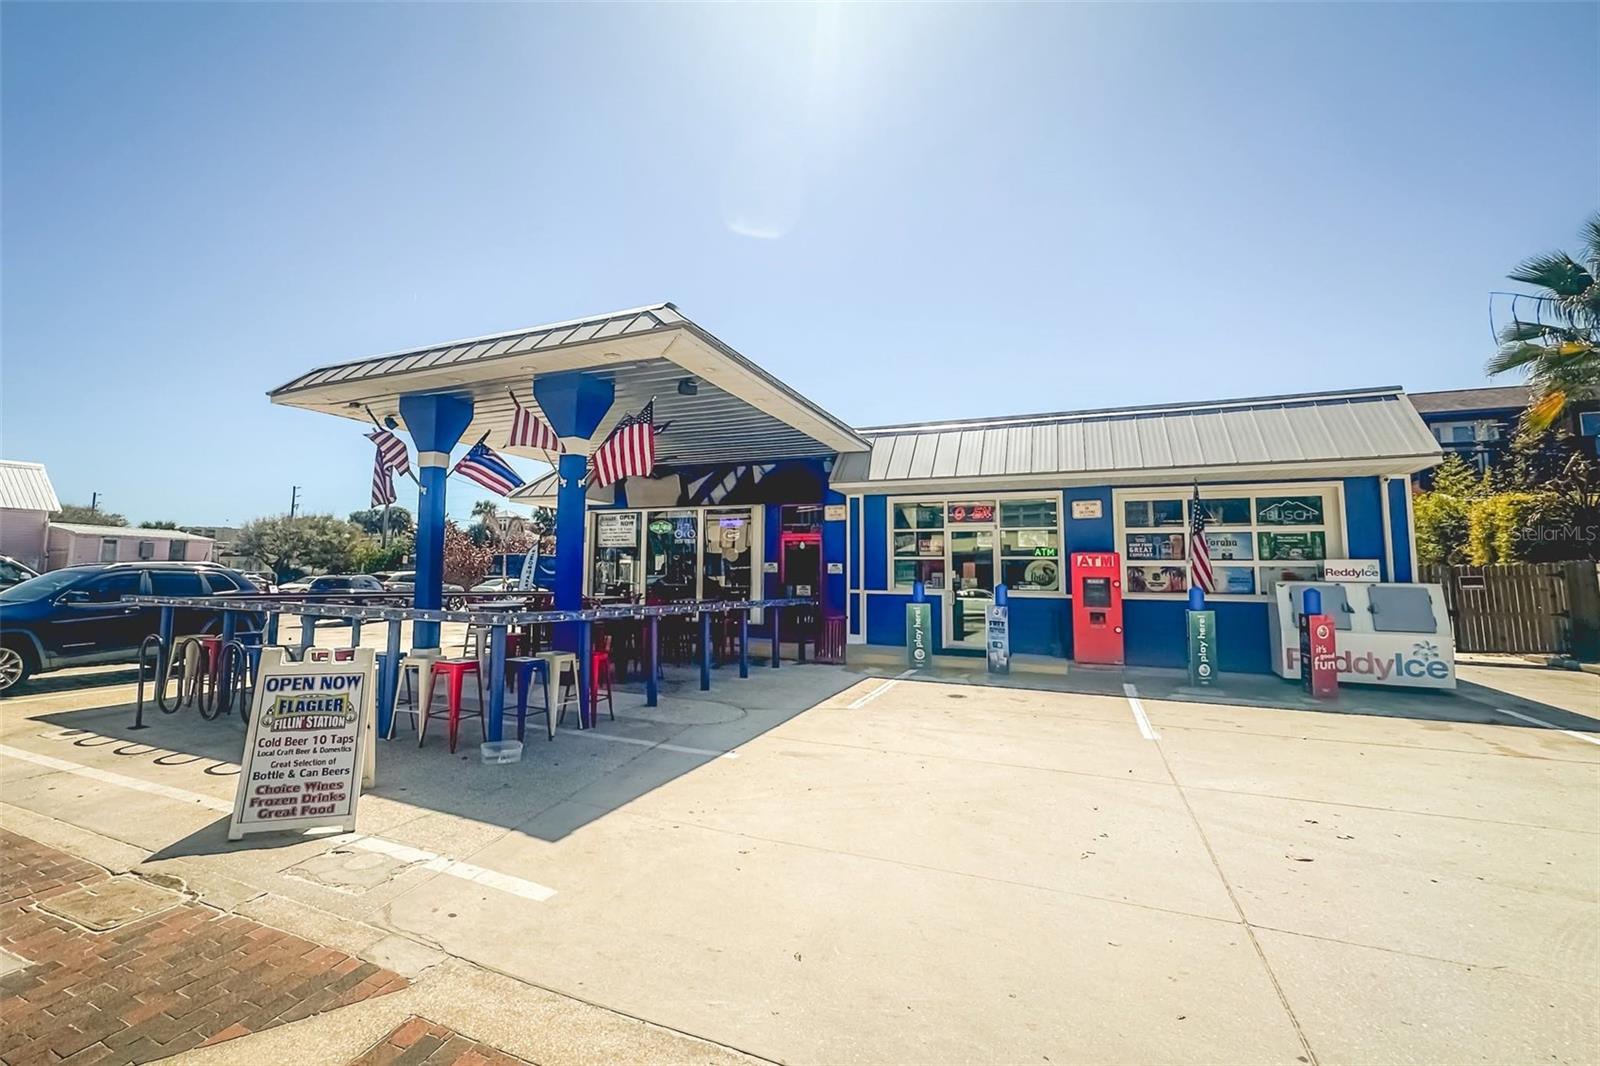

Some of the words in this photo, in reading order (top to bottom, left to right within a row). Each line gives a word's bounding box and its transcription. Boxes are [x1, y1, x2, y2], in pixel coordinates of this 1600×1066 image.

[1266, 510, 1313, 520] BUSCH
[1034, 548, 1055, 556] ATM
[1077, 555, 1114, 567] ATM
[913, 628, 924, 648] play
[1197, 640, 1209, 663] play
[1315, 644, 1327, 654] it's
[1314, 656, 1336, 670] fun
[266, 677, 315, 692] OPEN
[320, 675, 362, 690] NOW
[278, 698, 344, 714] FLAGLER
[306, 715, 345, 729] STATION
[258, 737, 281, 748] Cold
[284, 736, 308, 747] Beer
[312, 735, 327, 745] 10
[330, 734, 354, 745] Taps
[257, 749, 275, 757] Local
[276, 748, 294, 756] Craft
[319, 746, 352, 754] Domestics
[270, 760, 291, 769] Great
[293, 759, 327, 768] Selection
[328, 757, 337, 765] of
[252, 770, 285, 781] Bottle
[287, 769, 296, 778] &
[299, 768, 319, 778] Can
[321, 767, 350, 776] Beers
[255, 784, 301, 795] Choice
[304, 781, 345, 792] Wines
[249, 796, 298, 808] Frozen
[300, 792, 346, 804] Drinks
[257, 806, 298, 819] Great
[300, 803, 336, 816] Food
